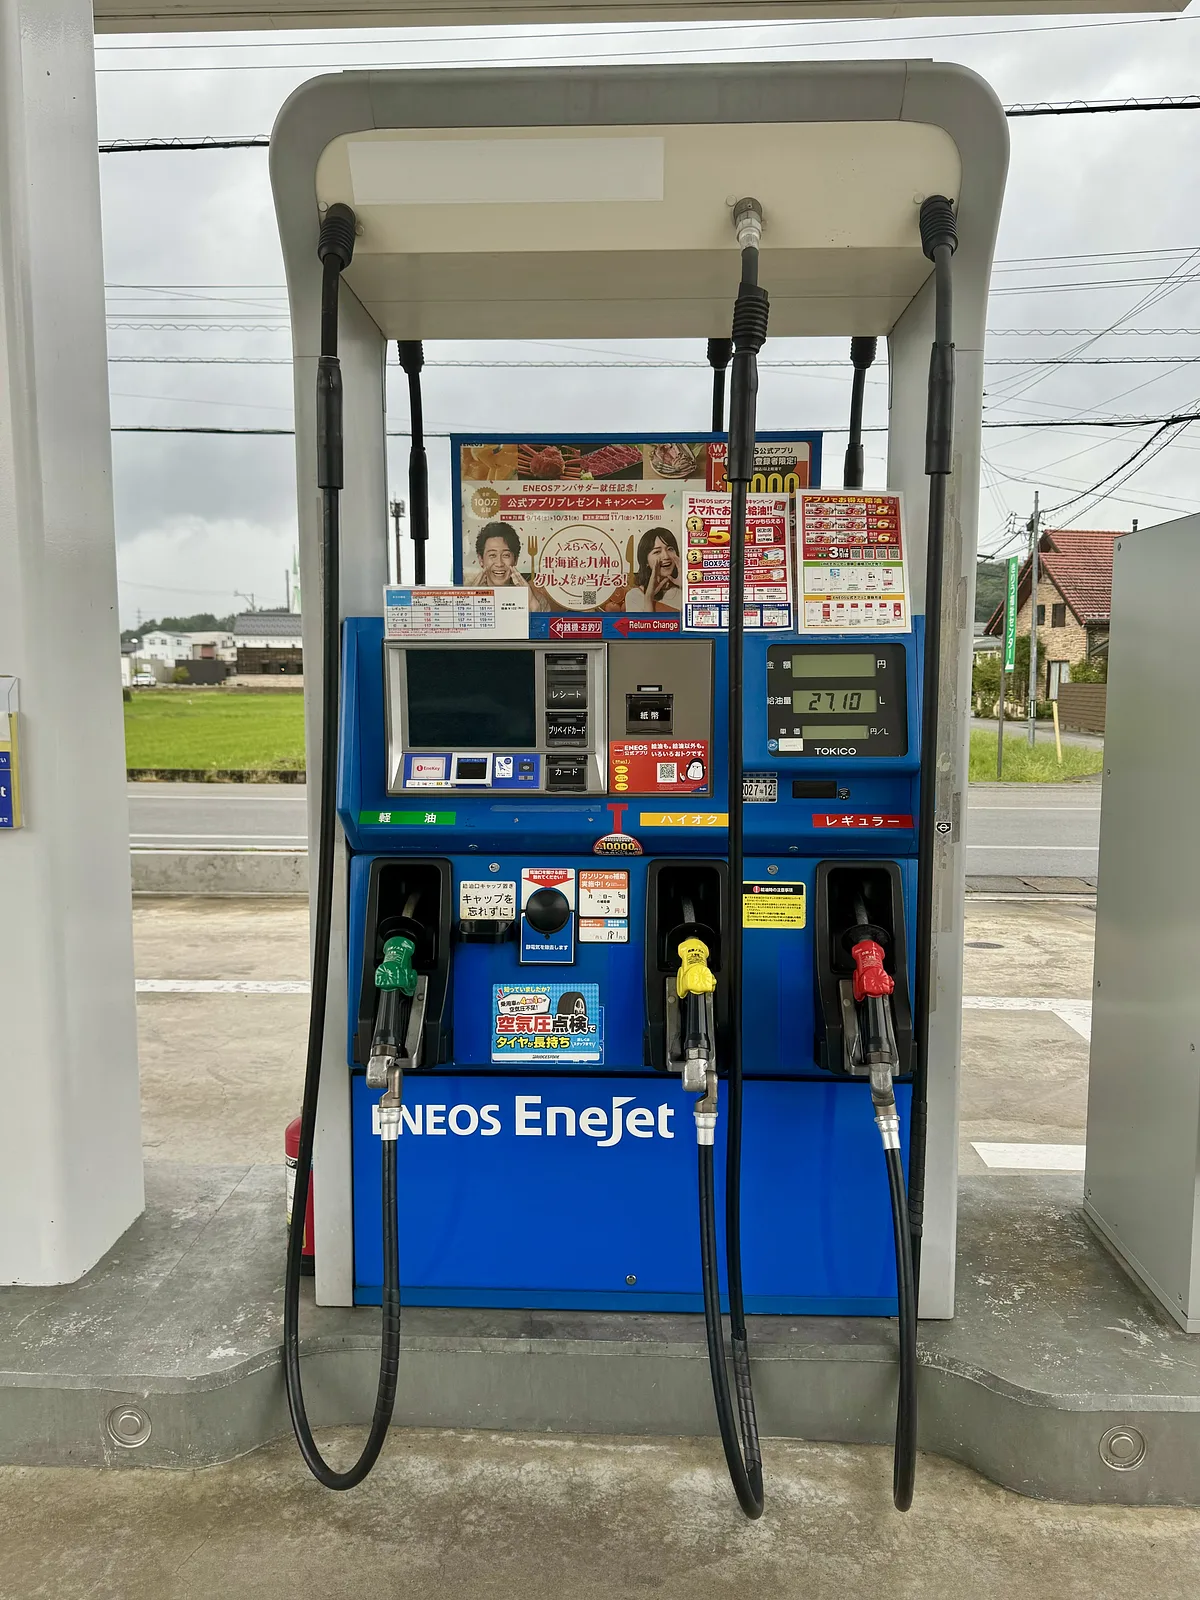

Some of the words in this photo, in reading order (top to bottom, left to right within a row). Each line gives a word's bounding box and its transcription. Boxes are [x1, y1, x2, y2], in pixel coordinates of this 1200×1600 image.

[713, 444, 723, 452] W
[523, 484, 638, 492] ENEOSアンバサダー就任記念!
[474, 498, 498, 506] 100万
[508, 498, 602, 508] 公式アプリプレゼント
[605, 498, 653, 506] キャンペーン
[688, 505, 772, 515] スマホでお給油!!
[876, 506, 888, 515] 8
[878, 519, 889, 528] 6
[708, 526, 730, 543] 5
[878, 533, 890, 543] 6
[829, 547, 838, 558] 3
[542, 556, 619, 568] 北海道と九州の
[653, 621, 678, 630] Change
[877, 660, 886, 668] 円
[808, 693, 861, 711] 27.10
[640, 712, 659, 720] 紙幣
[549, 726, 585, 734] プリペイドカード
[556, 768, 578, 776] カード
[378, 812, 436, 823] 軽油
[661, 814, 718, 825] ハイオク
[826, 815, 900, 826] レギュラー
[462, 893, 513, 904] キャップを
[468, 906, 514, 917] 忘れずに!
[497, 1016, 596, 1033] 空気圧点検で
[496, 1036, 570, 1048] タイヤが長持ち
